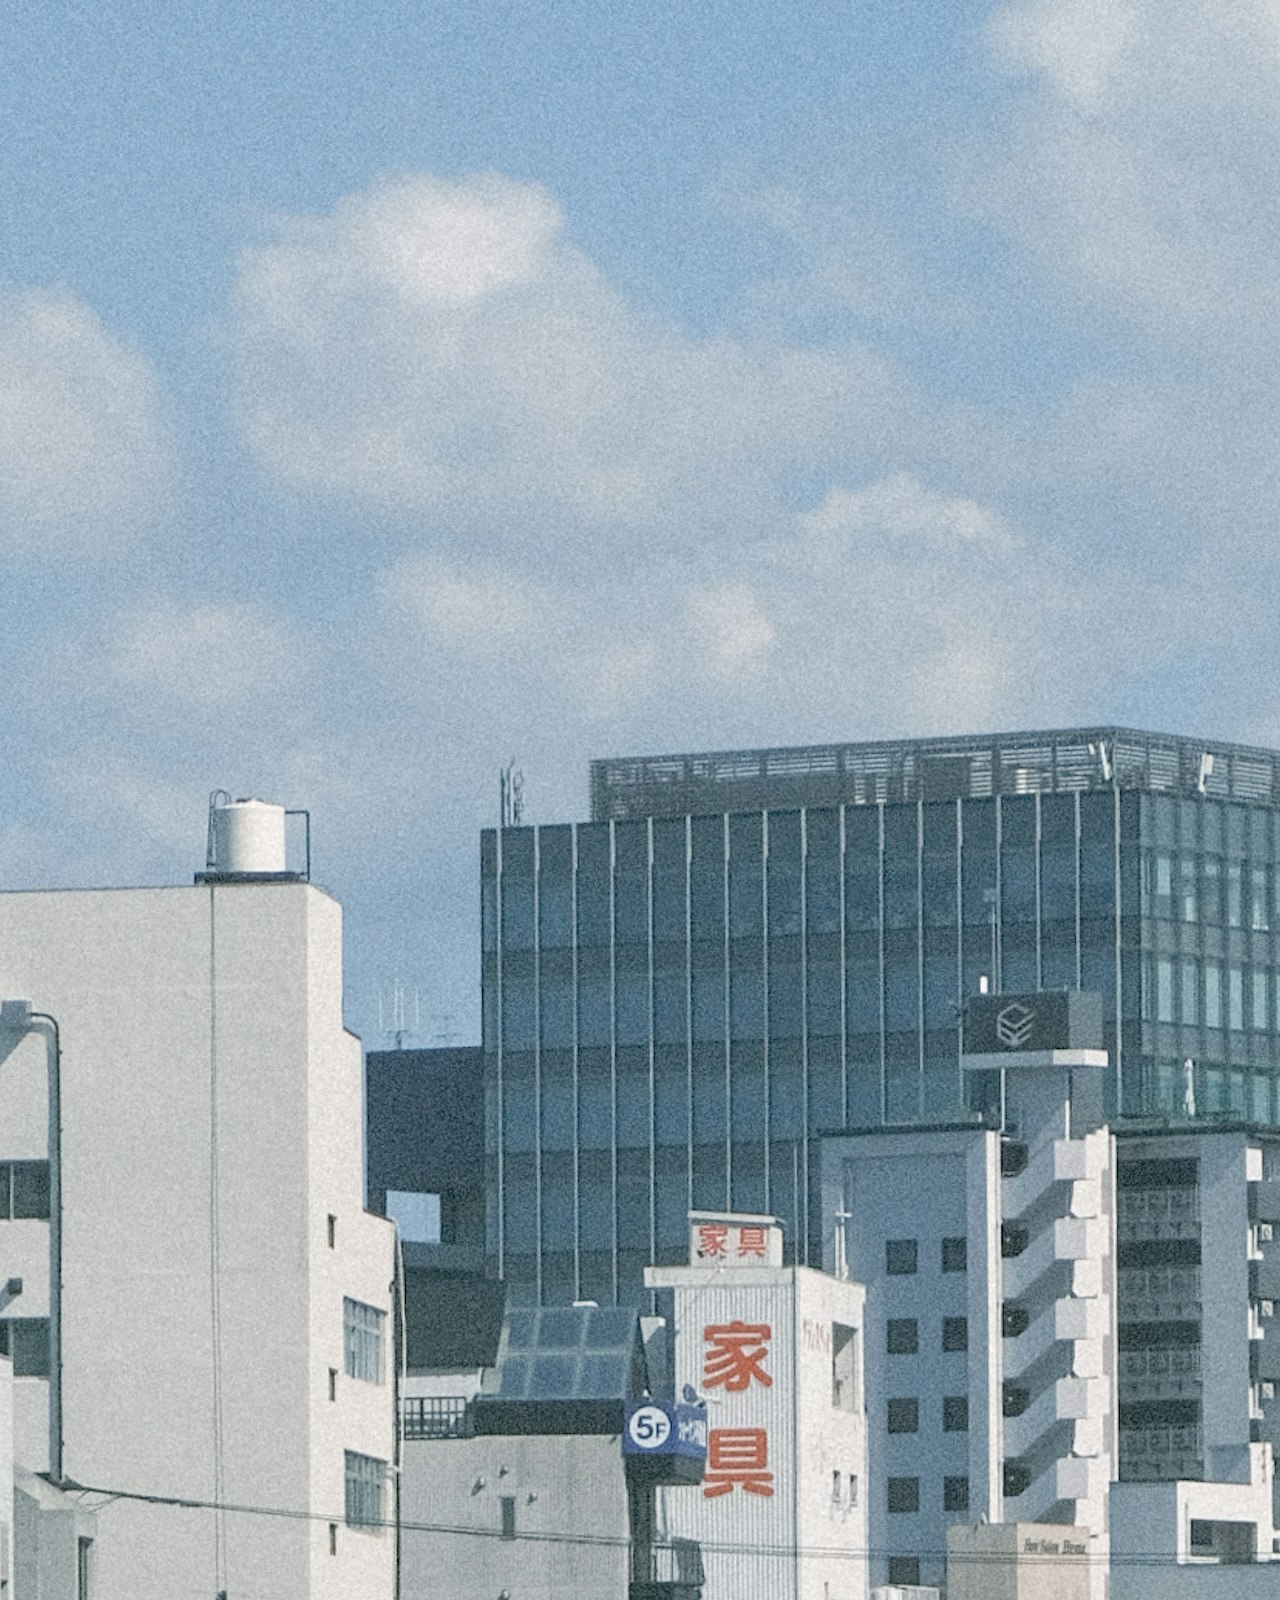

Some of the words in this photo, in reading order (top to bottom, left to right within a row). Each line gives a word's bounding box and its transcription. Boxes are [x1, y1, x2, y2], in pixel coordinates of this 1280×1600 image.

[699, 1225, 768, 1257] 家具
[703, 1320, 774, 1498] 家具
[636, 1415, 666, 1440] 5F
